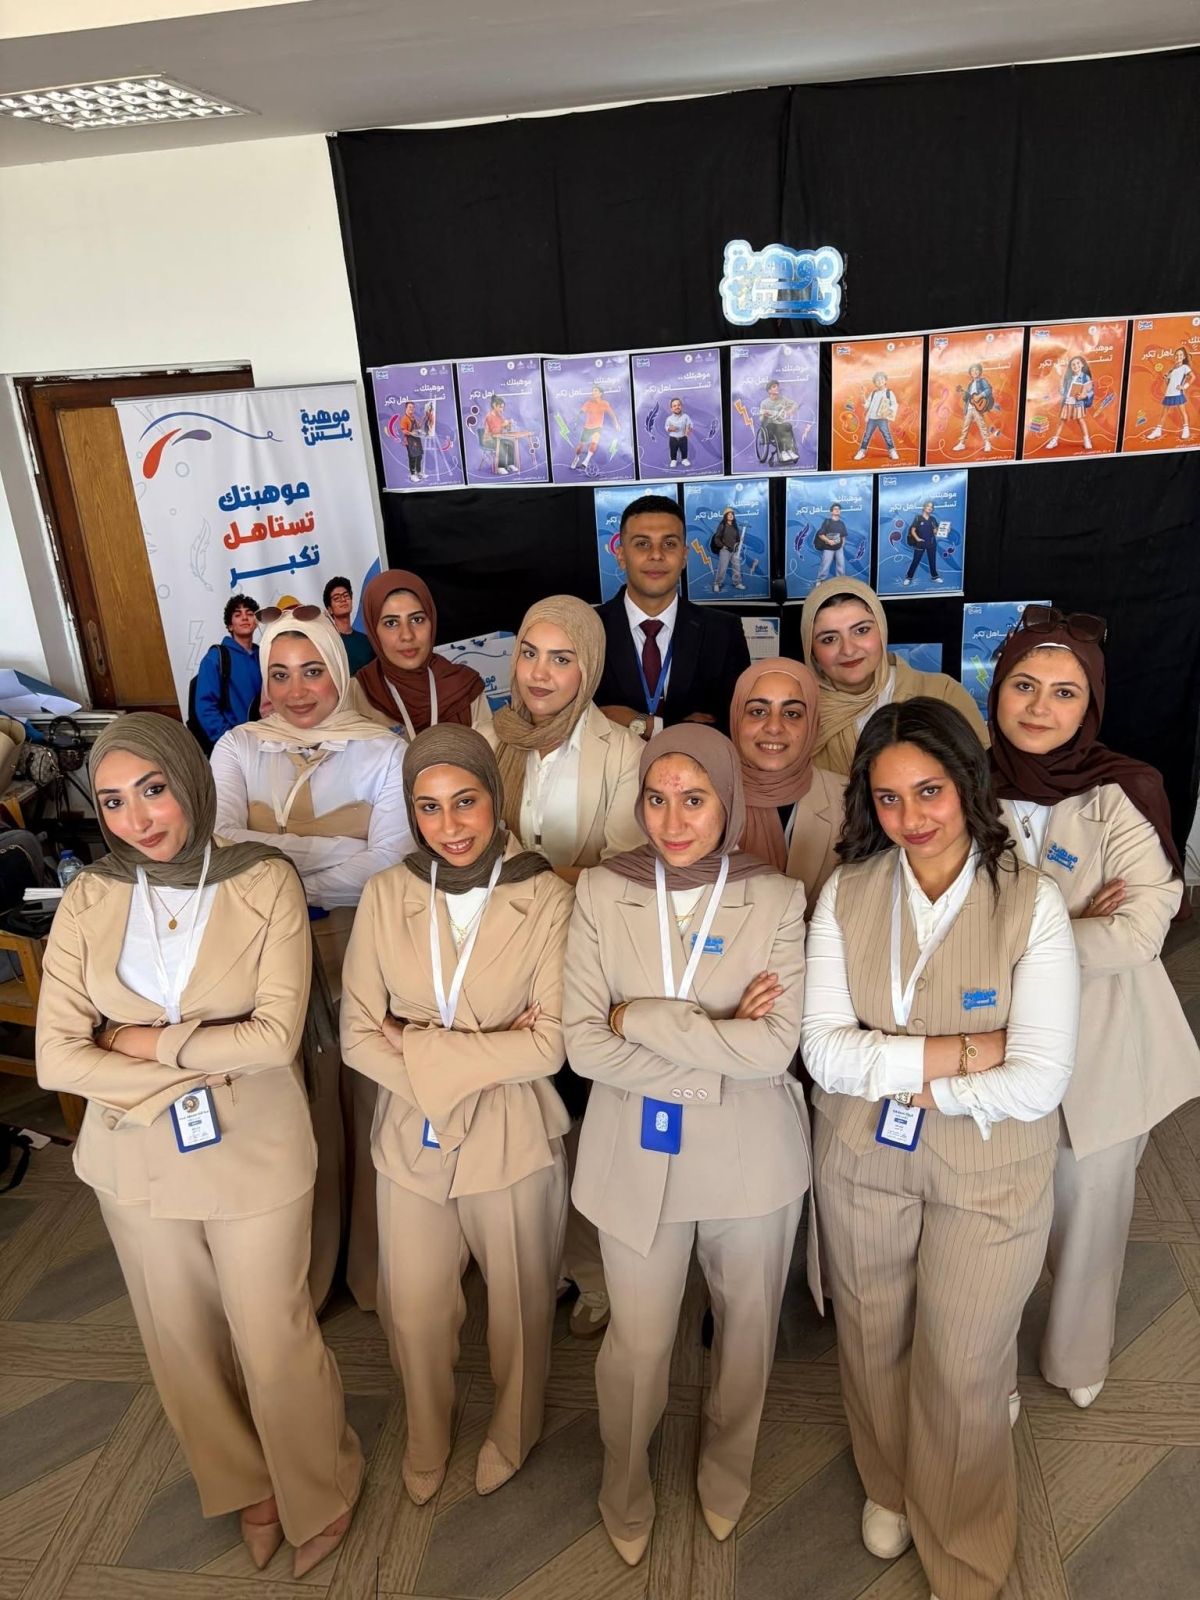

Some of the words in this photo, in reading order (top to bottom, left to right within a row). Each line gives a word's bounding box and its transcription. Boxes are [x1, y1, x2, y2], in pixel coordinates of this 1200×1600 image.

[1141, 350, 1156, 361] تكبر
[300, 408, 350, 430] موهبة
[303, 425, 353, 446] بلس
[218, 480, 310, 512] موهبتك
[223, 511, 315, 550] تستاهل
[230, 544, 320, 589] تكبر
